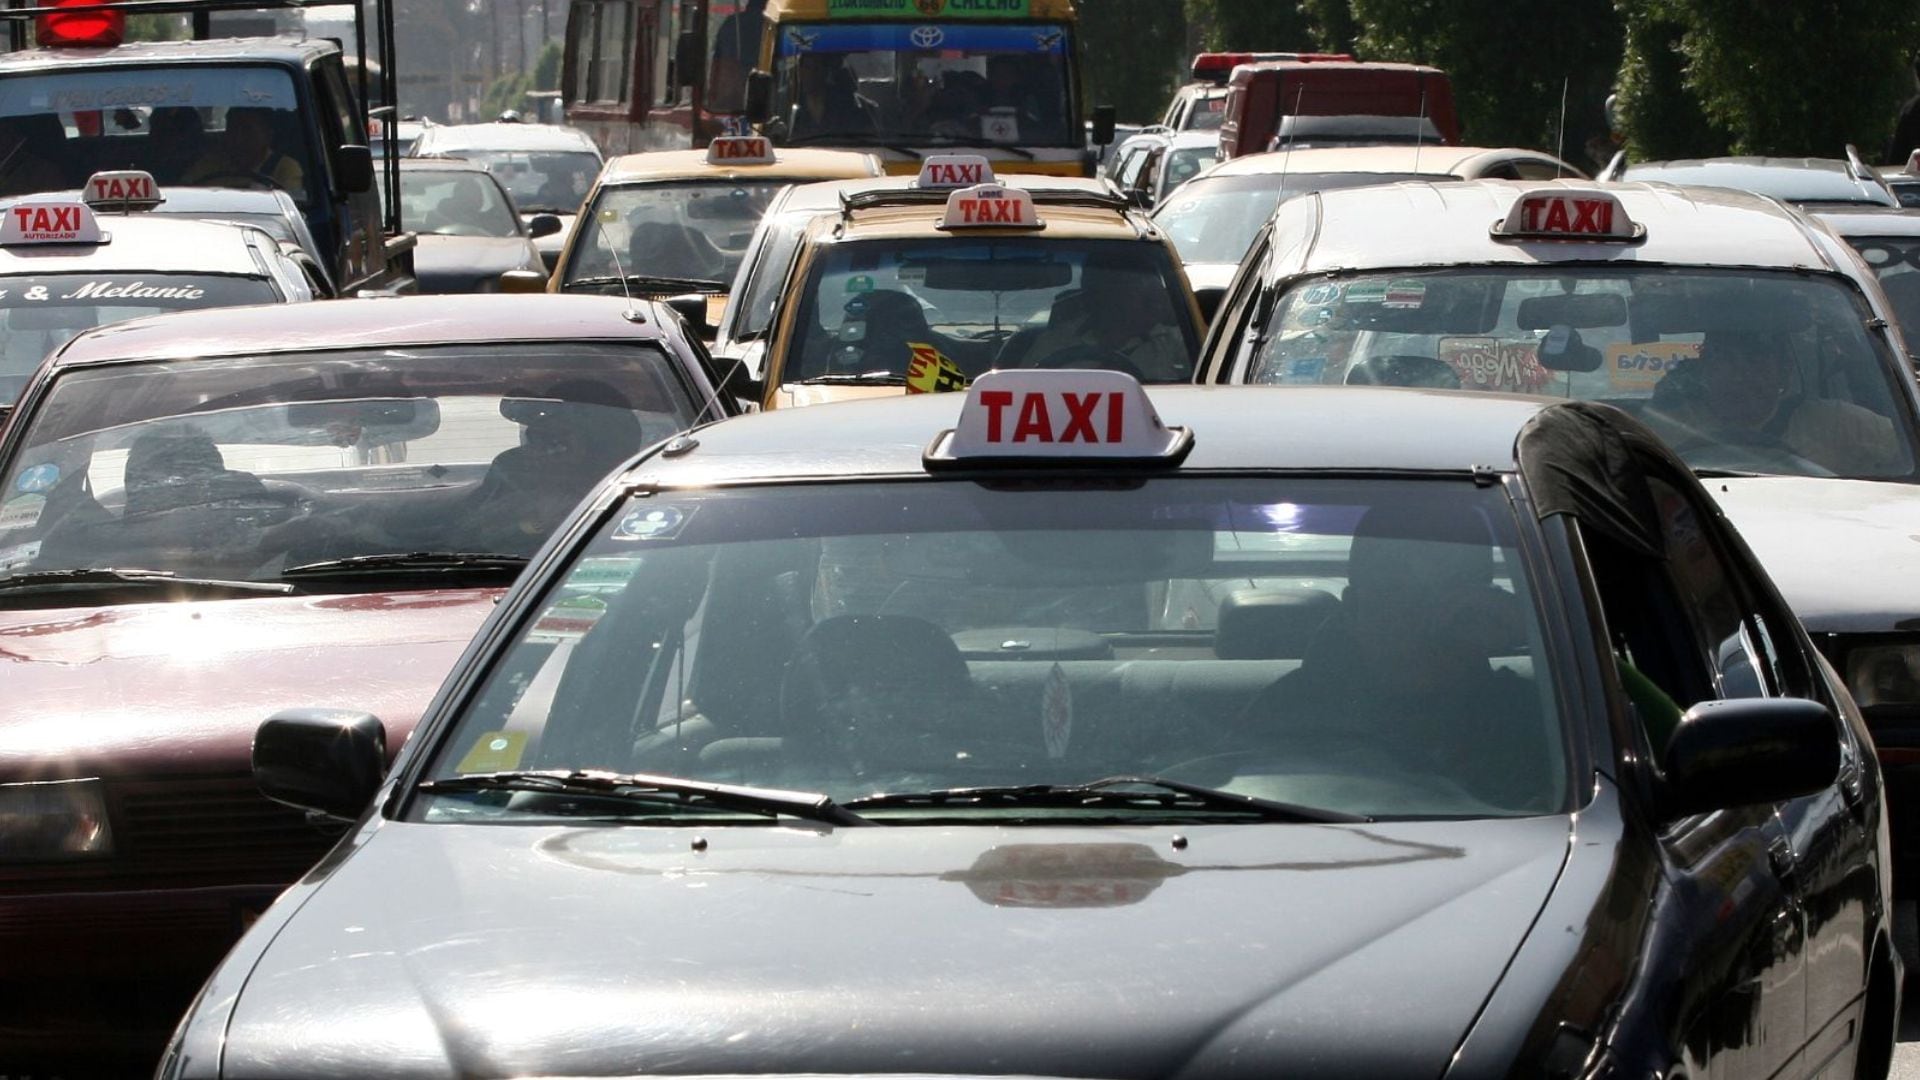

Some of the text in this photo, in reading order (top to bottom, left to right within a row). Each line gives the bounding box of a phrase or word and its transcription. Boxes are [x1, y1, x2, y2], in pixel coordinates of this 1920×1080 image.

[714, 140, 766, 158] TAXI
[926, 164, 983, 184] TAXI
[94, 179, 150, 198] TAXI
[14, 207, 81, 232] TAXI
[959, 199, 1022, 223] TAXI
[1525, 199, 1612, 233] TAXI
[24, 285, 49, 301] &
[62, 281, 205, 300] Melanie
[981, 391, 1124, 443] TAXI
